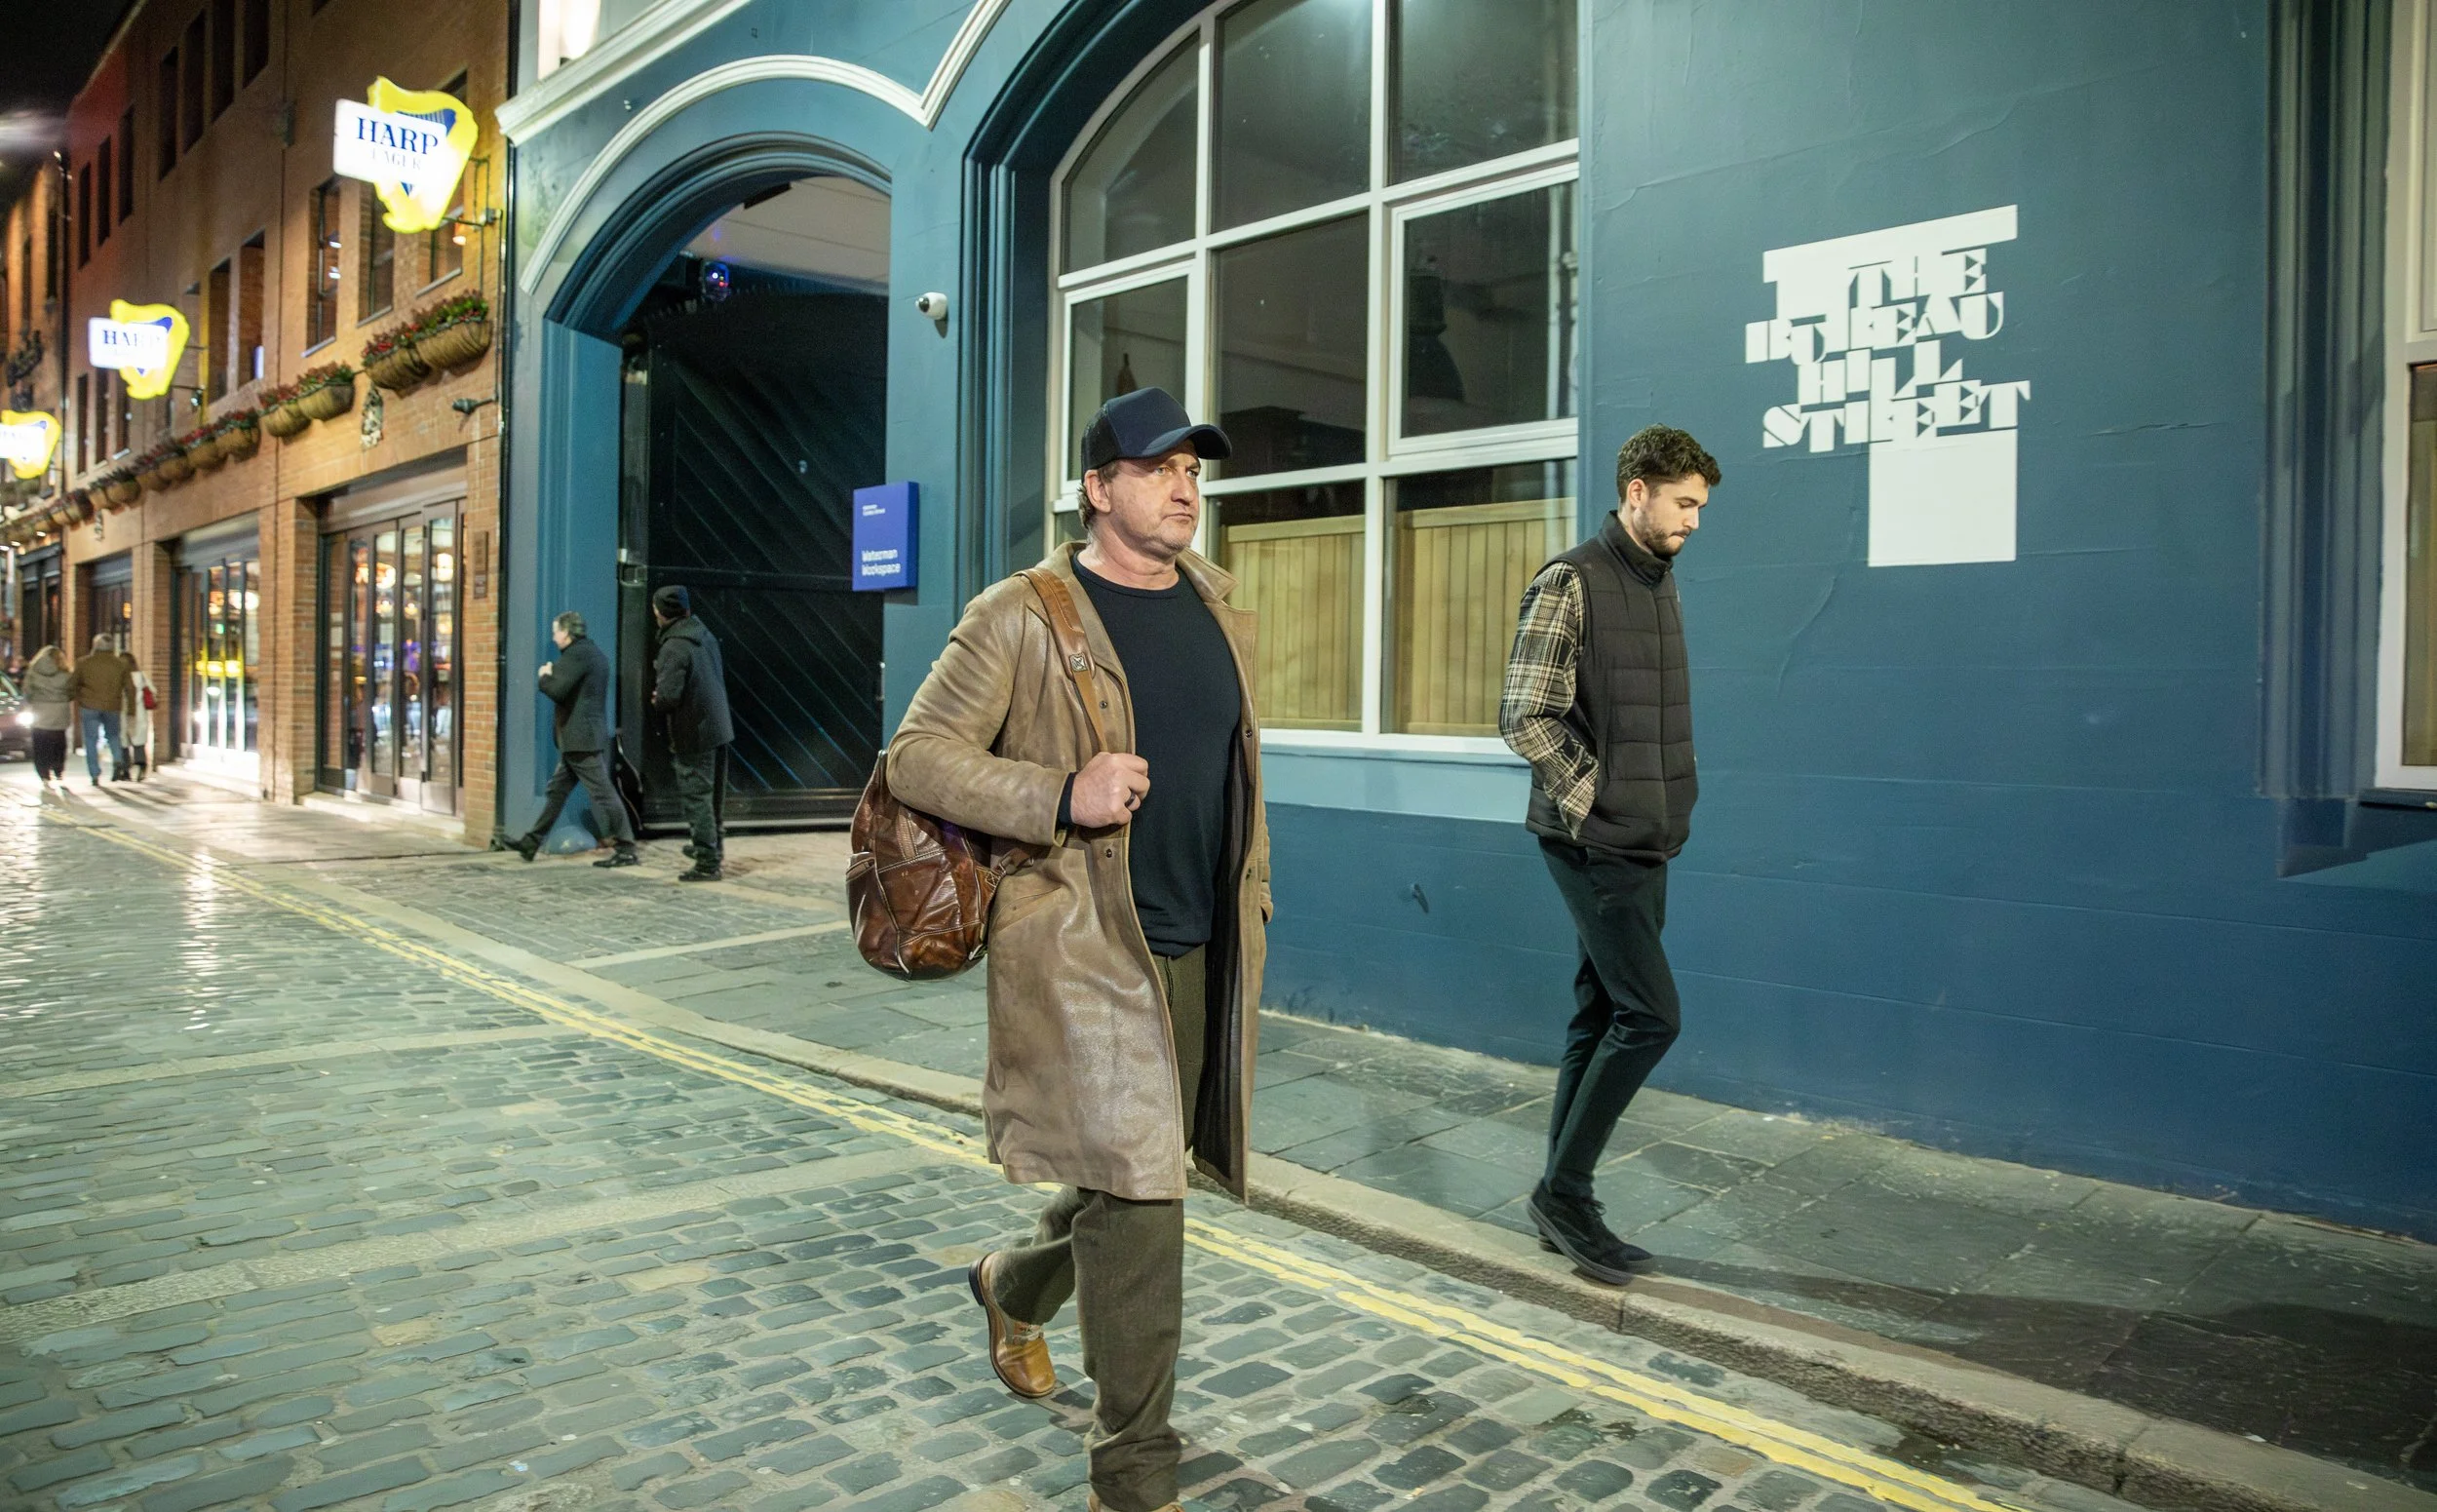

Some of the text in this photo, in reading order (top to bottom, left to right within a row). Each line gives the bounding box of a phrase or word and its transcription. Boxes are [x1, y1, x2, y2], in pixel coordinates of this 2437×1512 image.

[357, 117, 439, 155] HARP
[102, 330, 161, 347] HA
[1745, 291, 2004, 366] BUREAU
[1798, 339, 1963, 406] HILL
[1762, 379, 2031, 453] STREET
